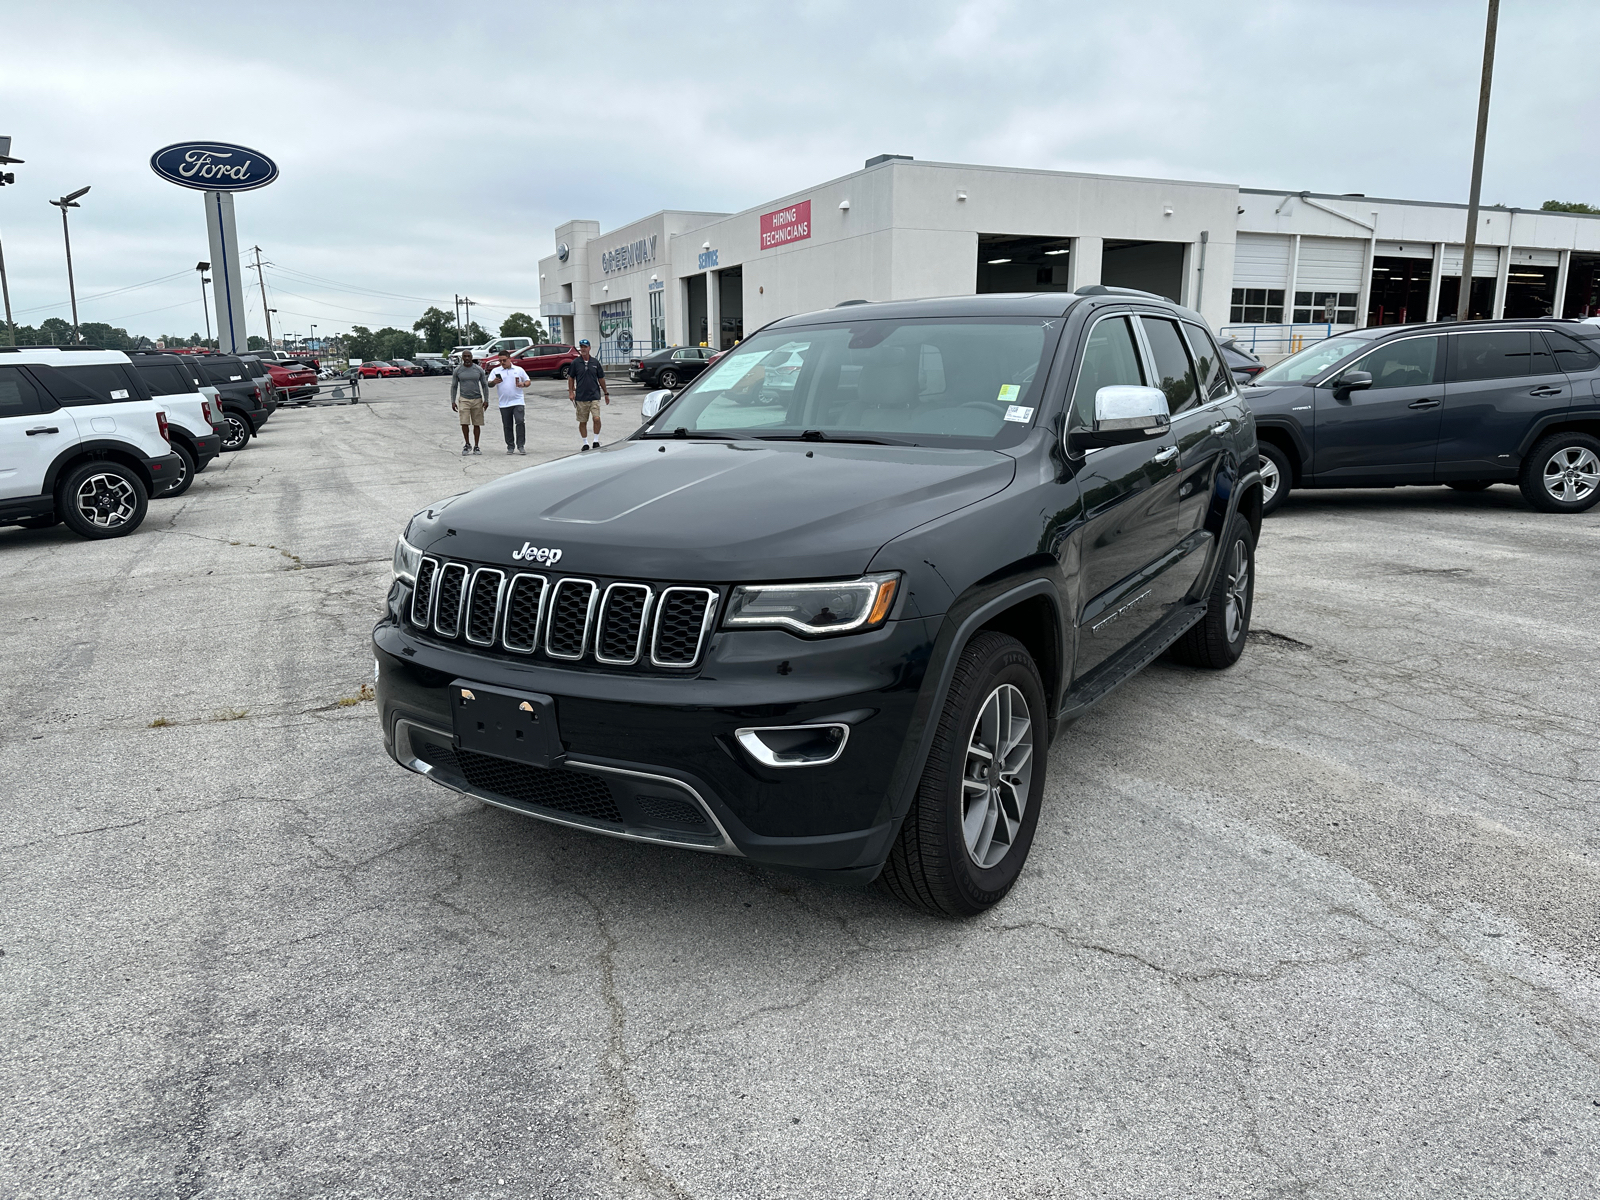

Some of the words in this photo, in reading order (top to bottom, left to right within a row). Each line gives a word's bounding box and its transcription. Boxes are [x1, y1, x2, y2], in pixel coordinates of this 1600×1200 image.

[179, 150, 251, 180] Ford
[772, 208, 797, 228] HIRING
[762, 221, 808, 247] TECHNICIANS
[601, 235, 657, 273] GREENWAY
[698, 249, 719, 270] SERVICE
[512, 541, 562, 567] Jeep
